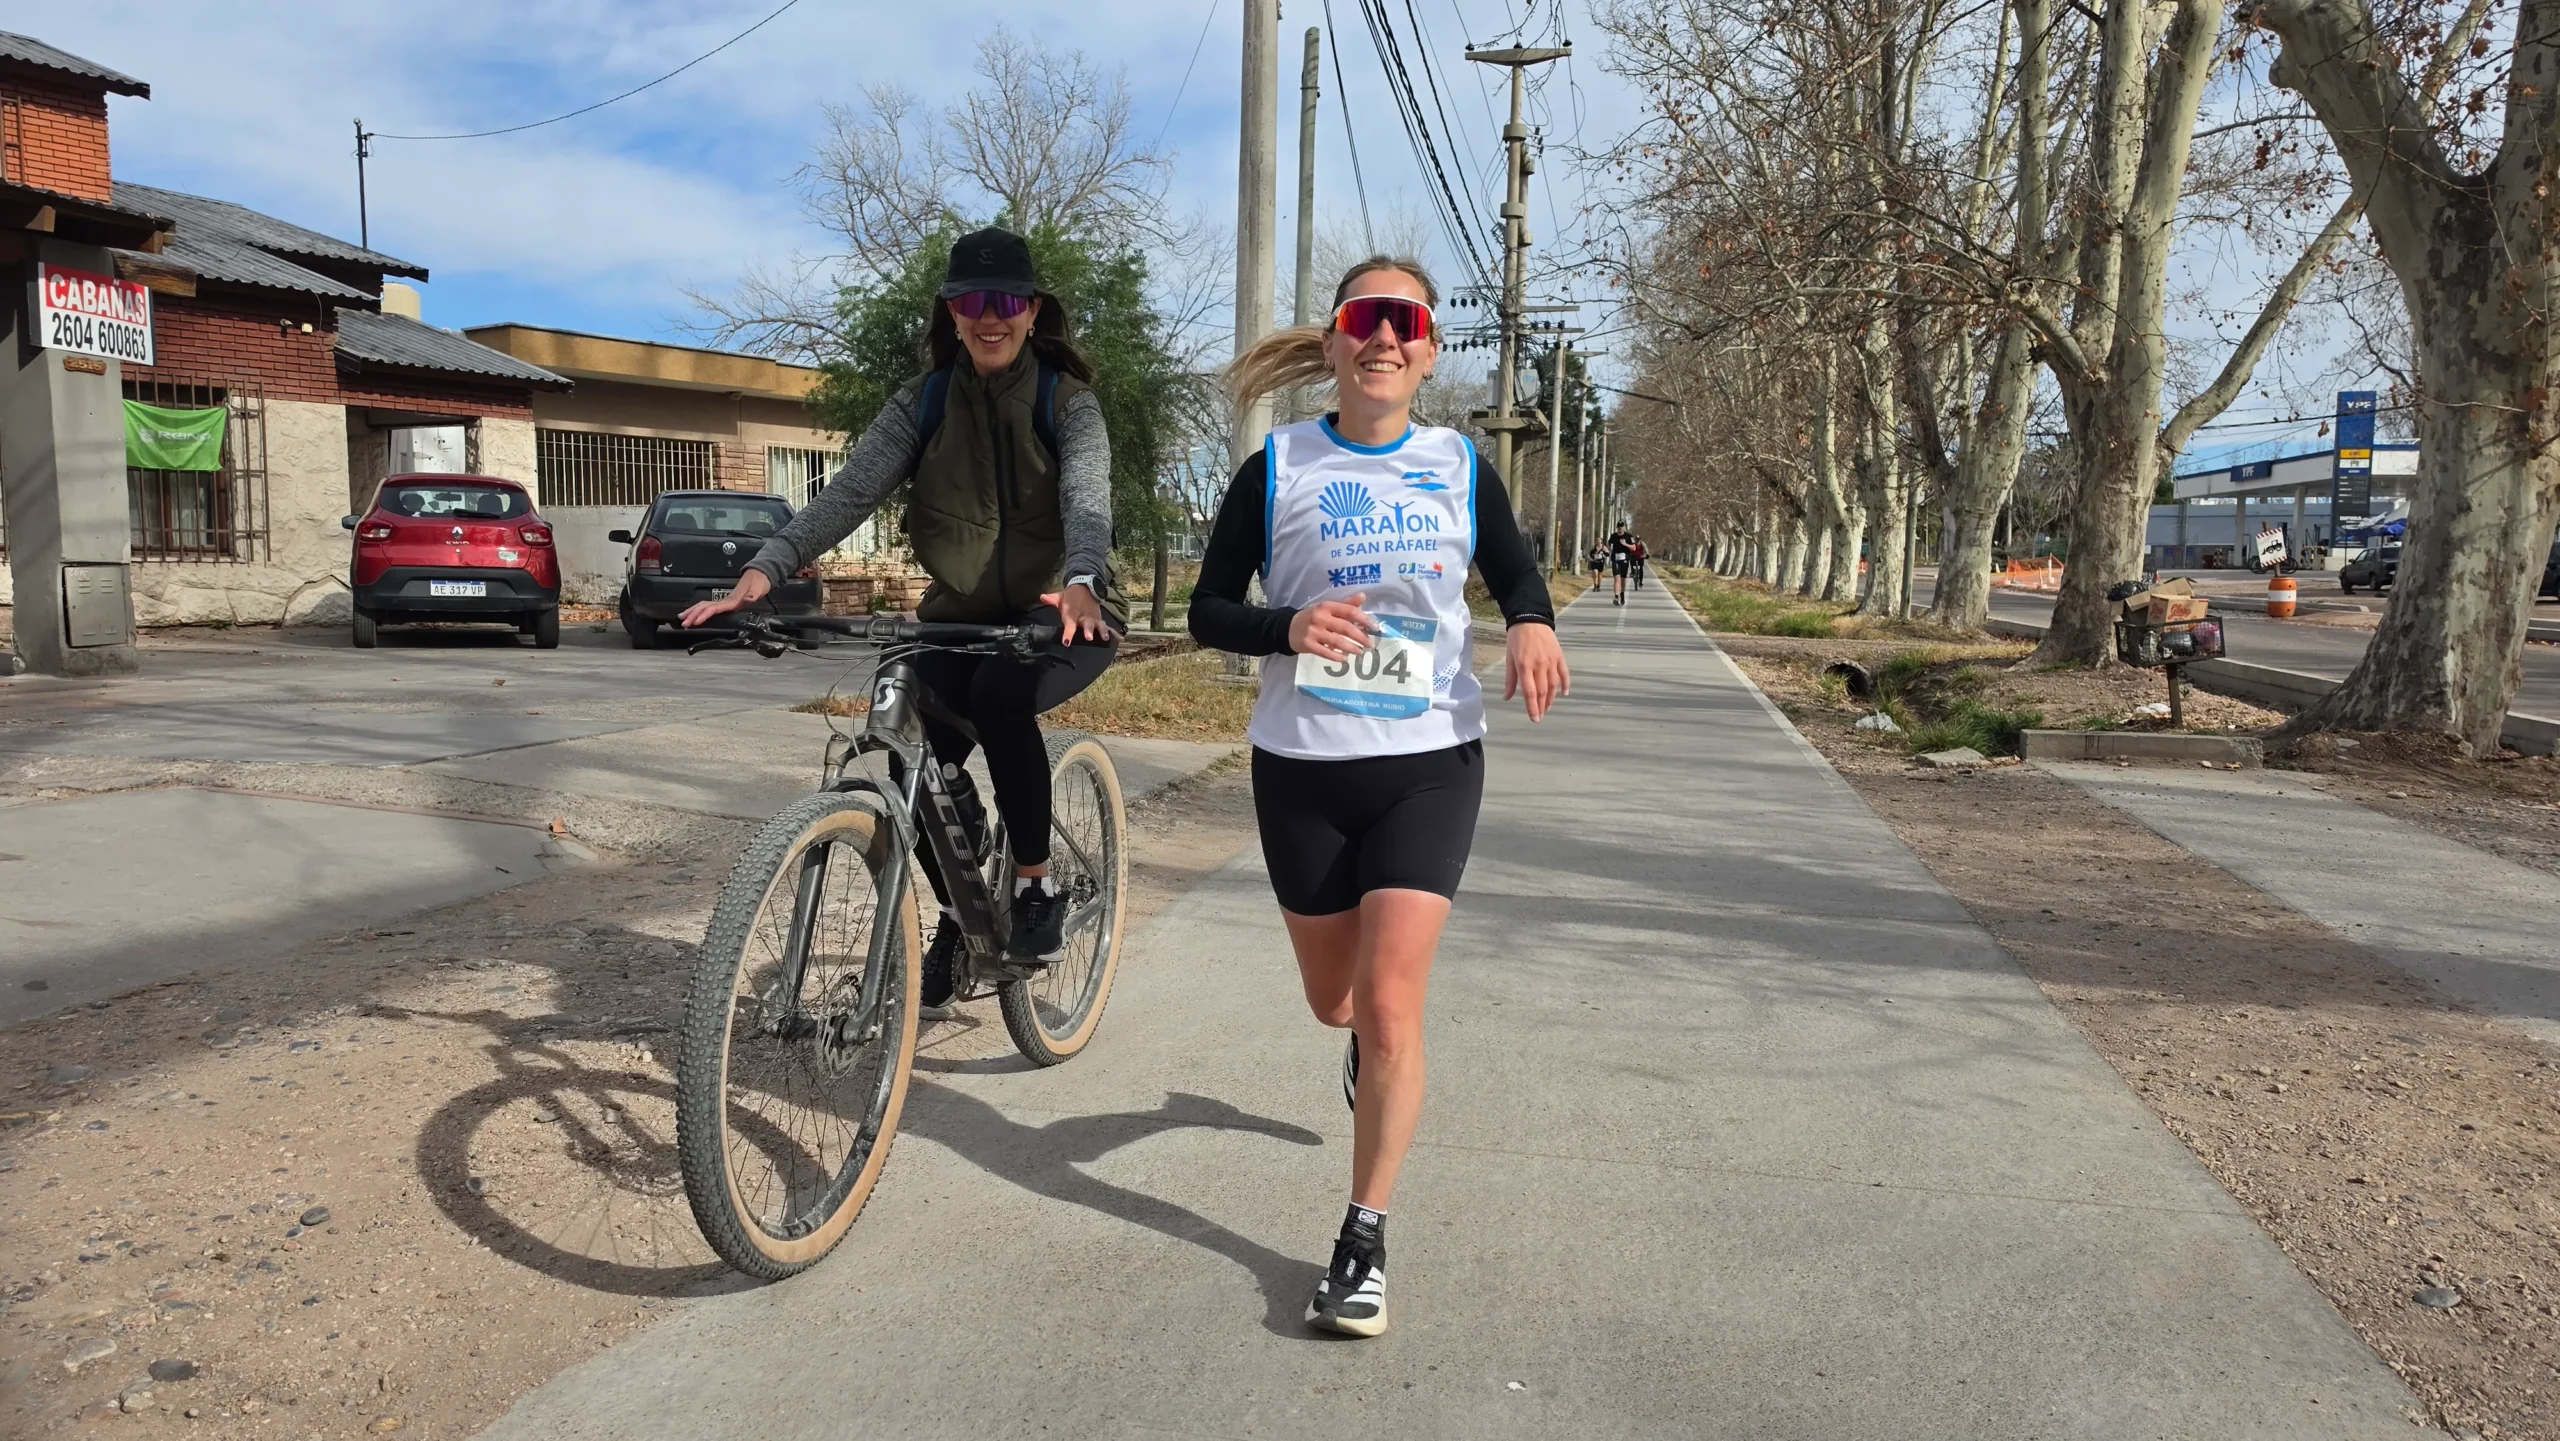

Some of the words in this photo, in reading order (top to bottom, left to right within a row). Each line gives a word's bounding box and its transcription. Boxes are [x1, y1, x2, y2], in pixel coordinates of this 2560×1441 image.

[49, 273, 146, 325] CABAÑAS
[52, 311, 94, 351] 2604
[98, 320, 146, 361] 600863
[2346, 401, 2372, 409] YPF
[2242, 465, 2256, 478] YPF
[1331, 549, 1342, 558] DE
[1346, 541, 1380, 556] SAN
[1384, 539, 1438, 552] RAFAEL
[1346, 563, 1381, 577] UTN
[434, 585, 446, 594] AE
[449, 585, 468, 594] 317
[471, 586, 483, 595] VP
